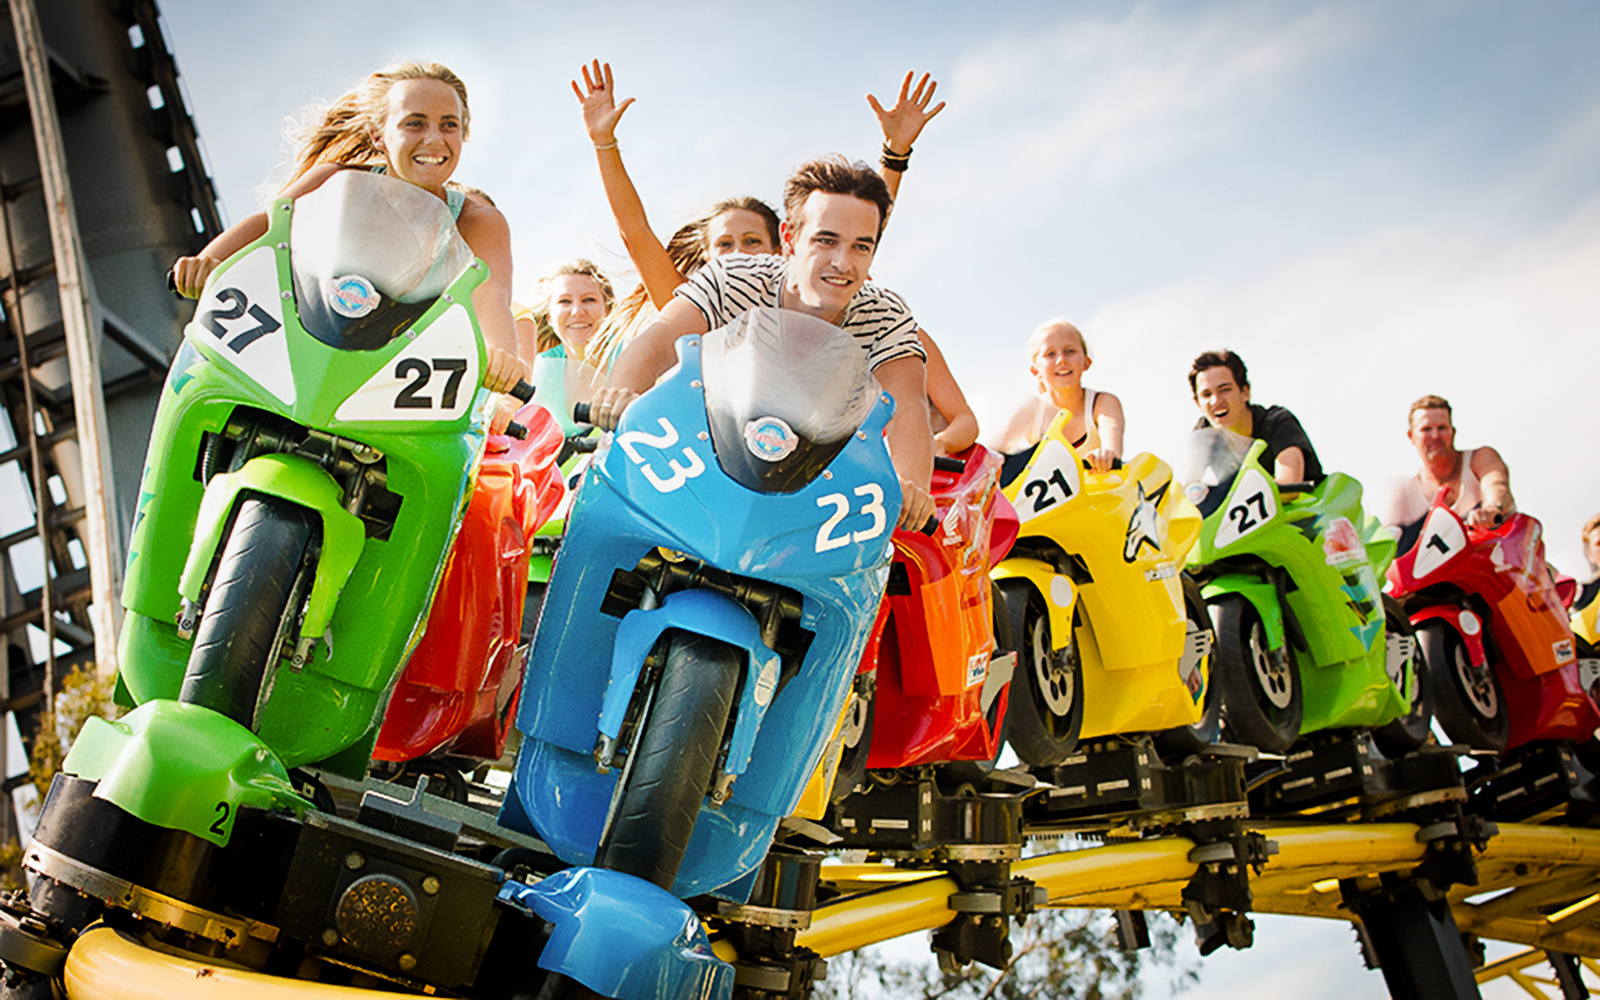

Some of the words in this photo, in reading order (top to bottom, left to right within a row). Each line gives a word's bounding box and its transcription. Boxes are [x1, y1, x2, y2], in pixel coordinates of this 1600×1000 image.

[200, 288, 282, 354] 27
[393, 358, 468, 410] 27
[616, 417, 706, 493] 23
[1025, 468, 1073, 513] 21
[1229, 491, 1269, 534] 27
[814, 482, 887, 553] 23
[1426, 533, 1450, 554] 1
[208, 801, 231, 836] 2
